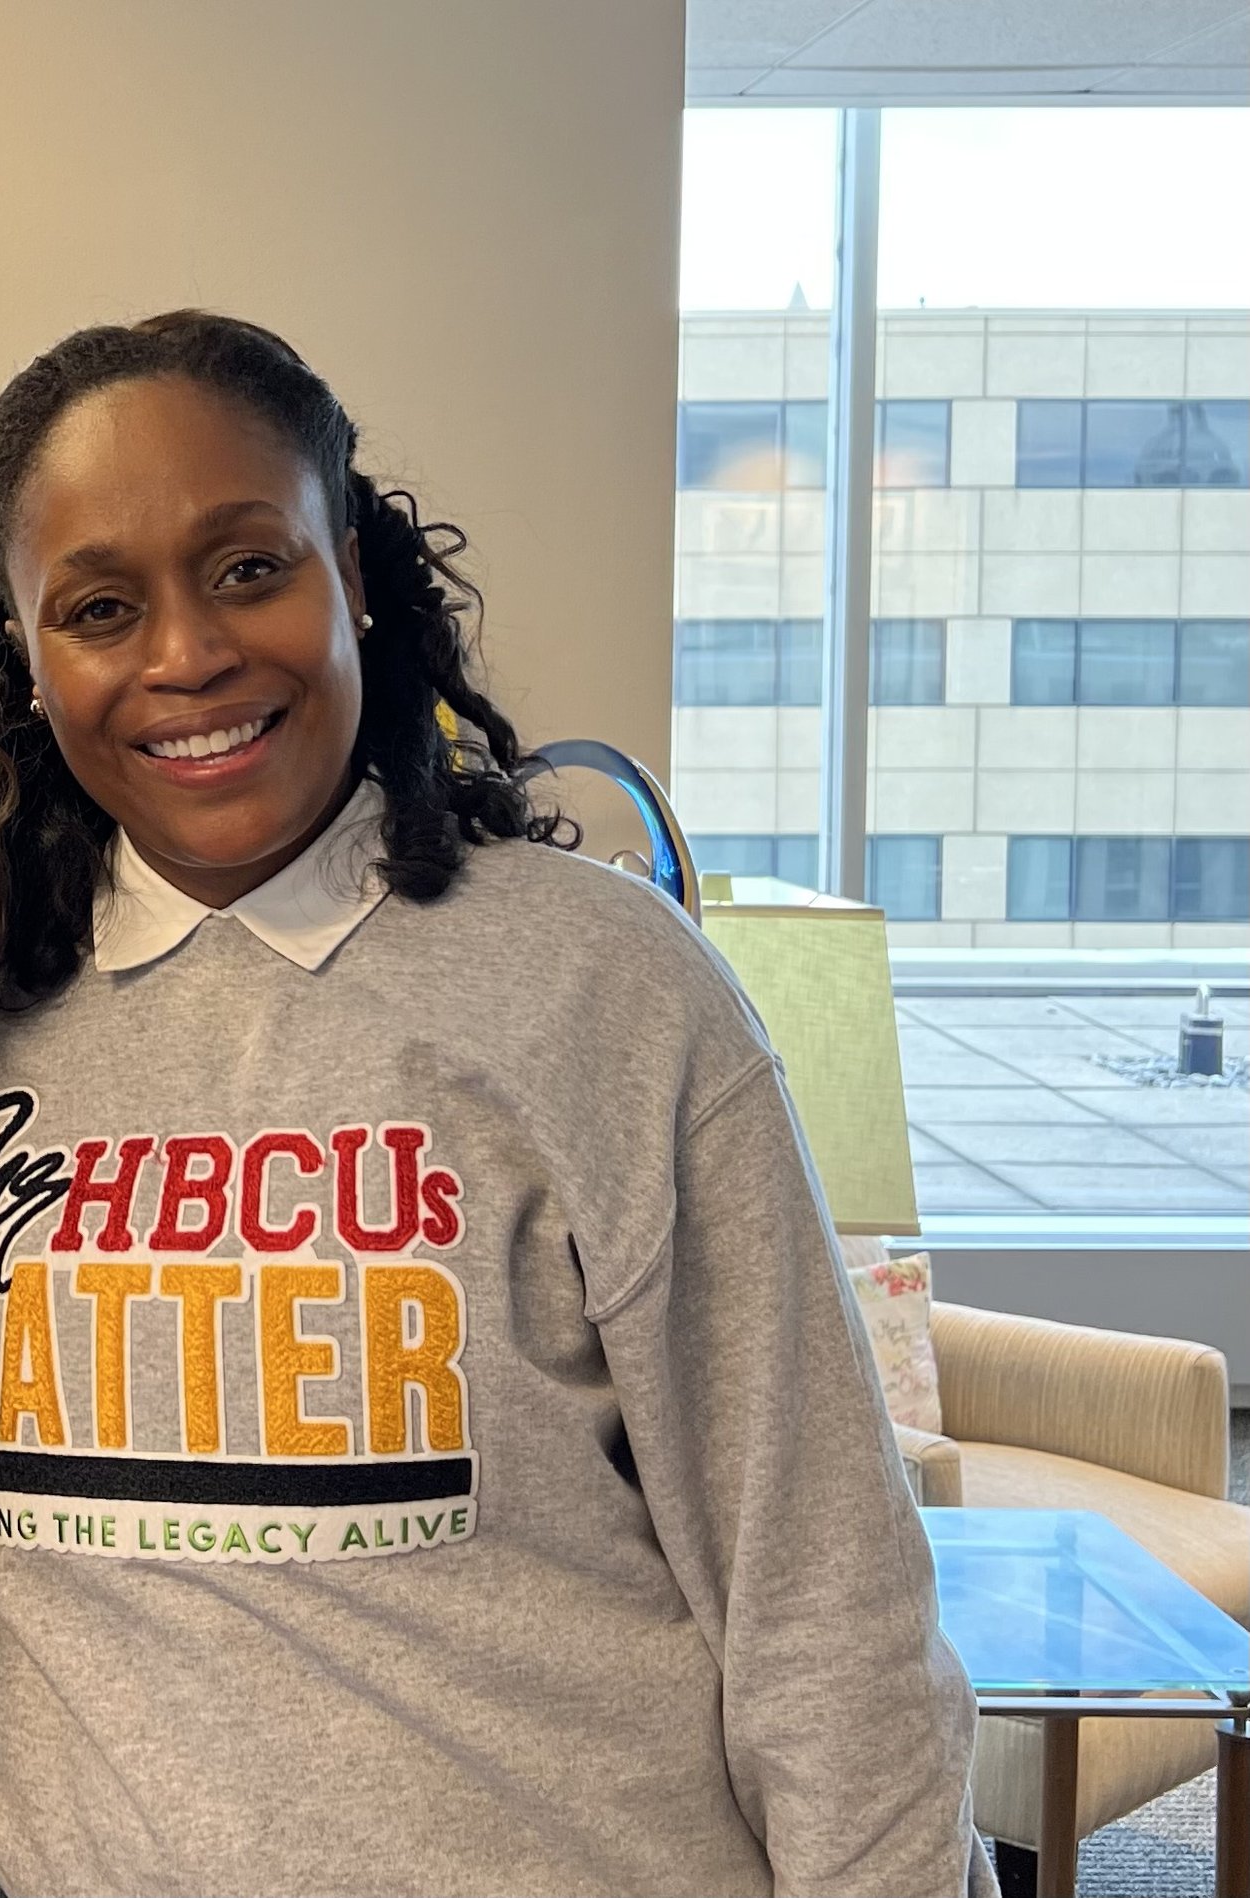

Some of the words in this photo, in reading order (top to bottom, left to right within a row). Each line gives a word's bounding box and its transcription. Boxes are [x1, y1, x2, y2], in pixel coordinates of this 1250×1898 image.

[50, 1127, 460, 1253] HBCUs
[52, 1511, 116, 1548] THE
[138, 1518, 317, 1553] LEGACY
[338, 1507, 469, 1551] ALIVE
